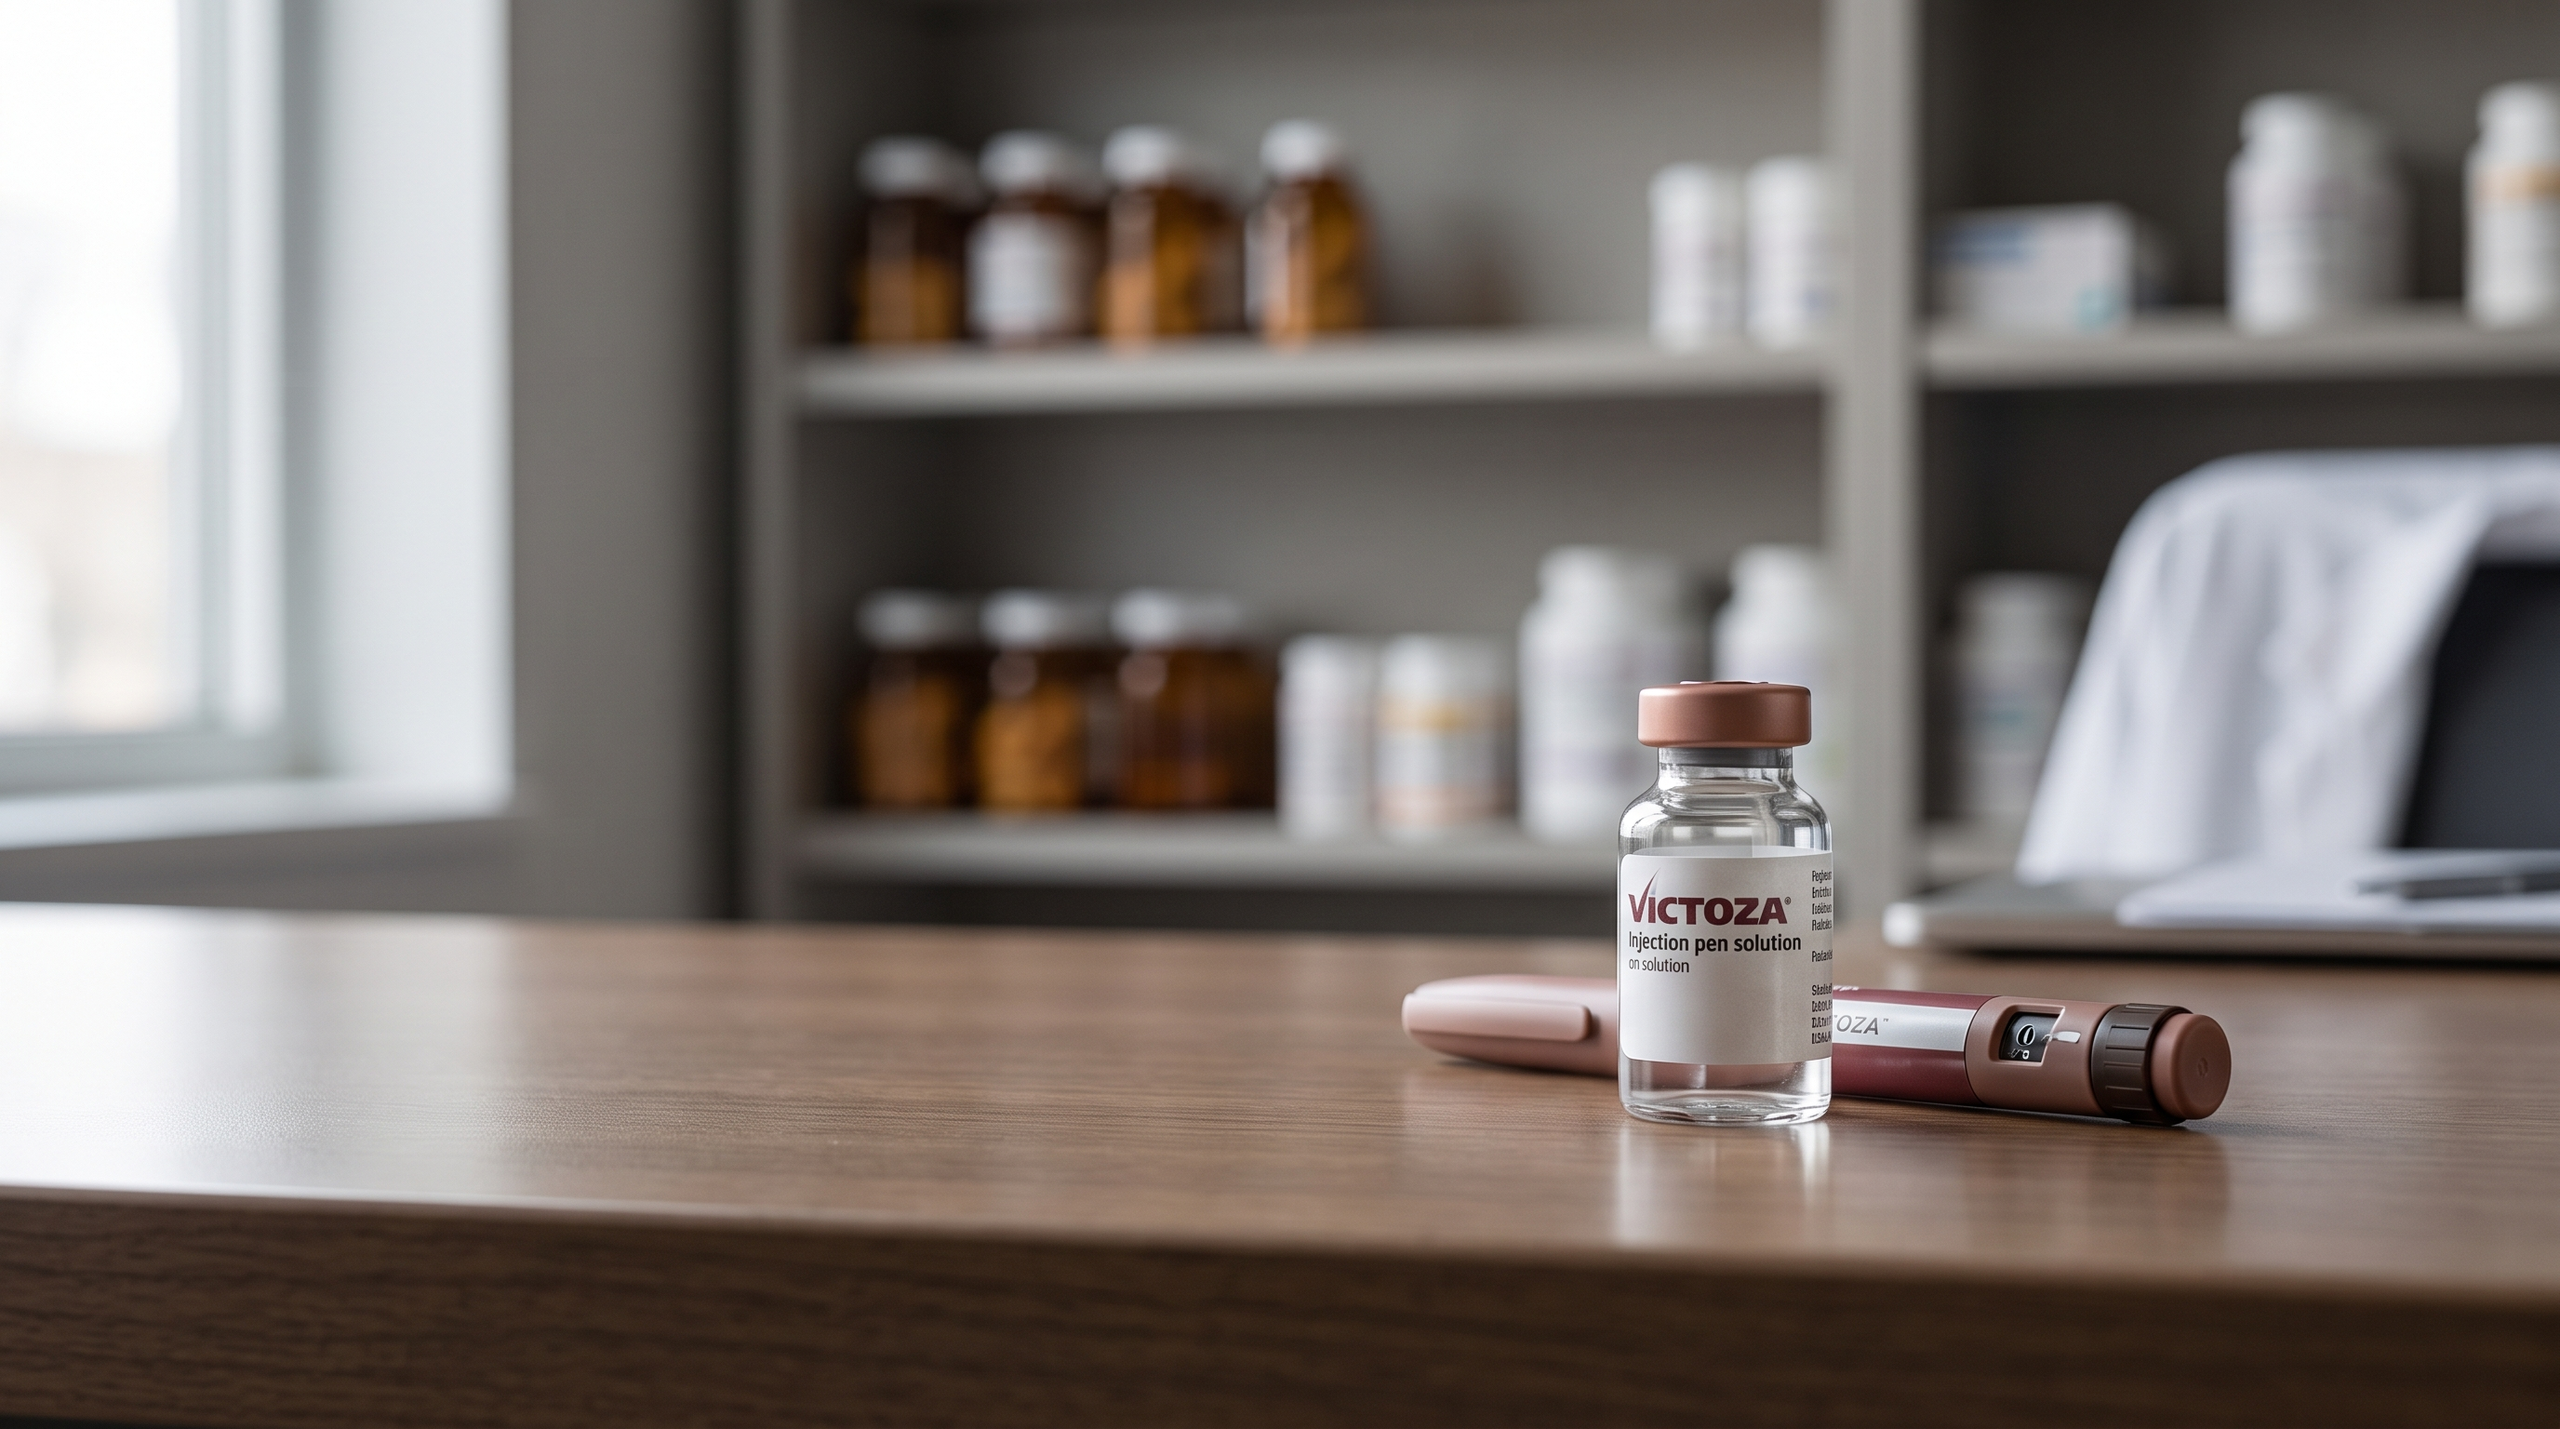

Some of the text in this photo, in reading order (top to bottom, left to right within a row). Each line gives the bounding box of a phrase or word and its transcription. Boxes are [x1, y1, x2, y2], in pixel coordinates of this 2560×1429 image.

[1629, 931, 1801, 956] Injection pen solution
[1629, 957, 1690, 973] on solution
[1834, 1015, 1889, 1036] OZA™
